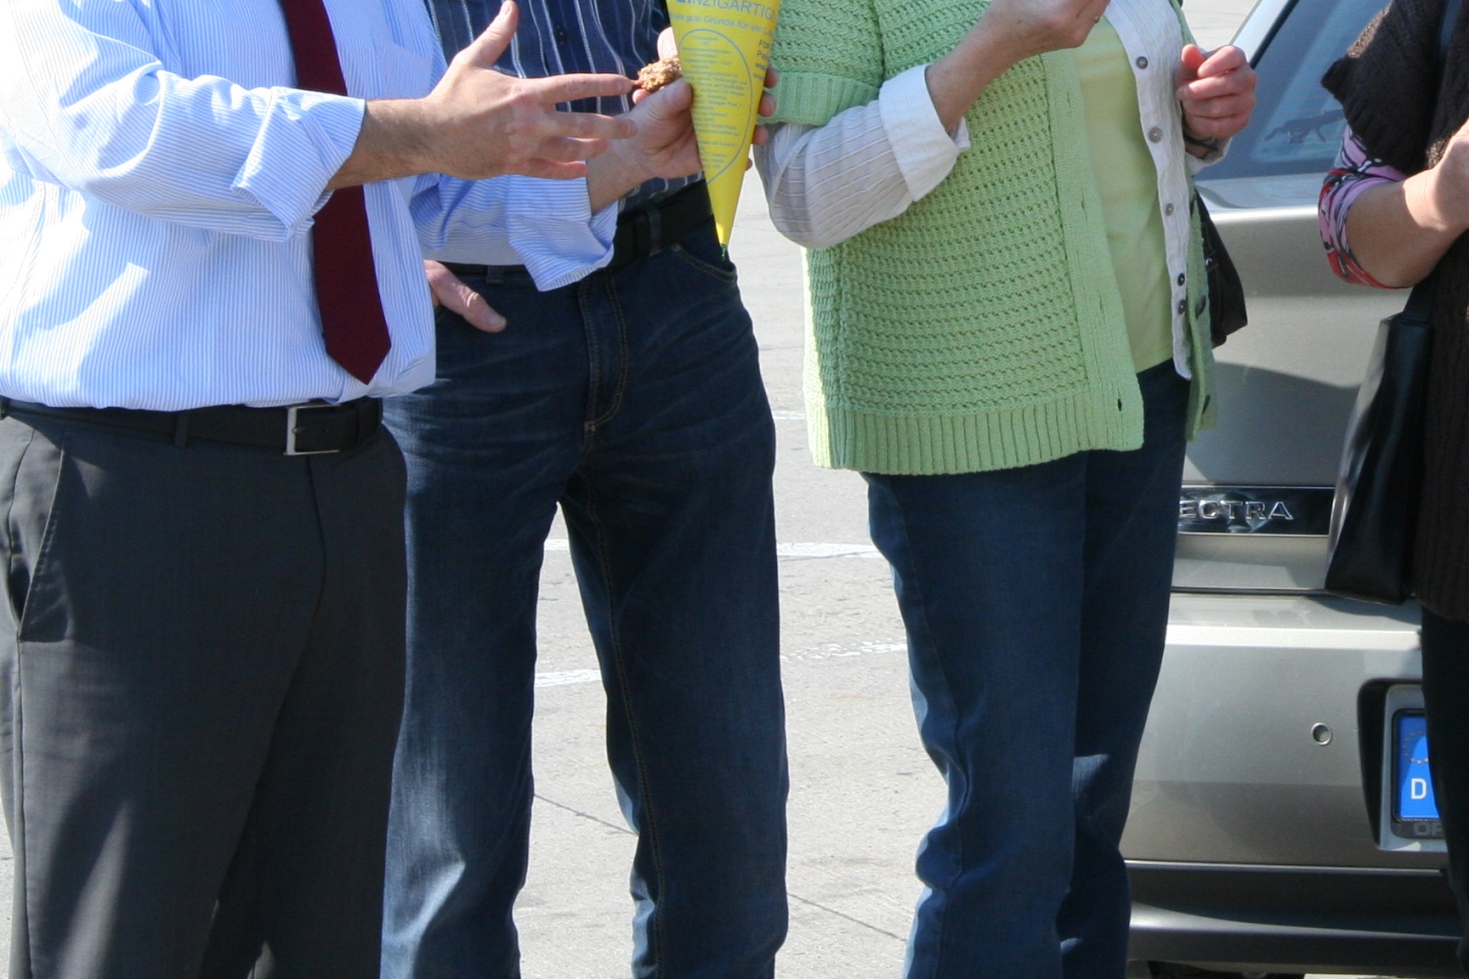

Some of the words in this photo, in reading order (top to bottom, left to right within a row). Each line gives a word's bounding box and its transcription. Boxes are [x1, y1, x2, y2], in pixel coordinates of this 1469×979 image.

[1179, 499, 1294, 520] ECTRA
[1410, 778, 1427, 800] D
[1413, 821, 1444, 837] OP
